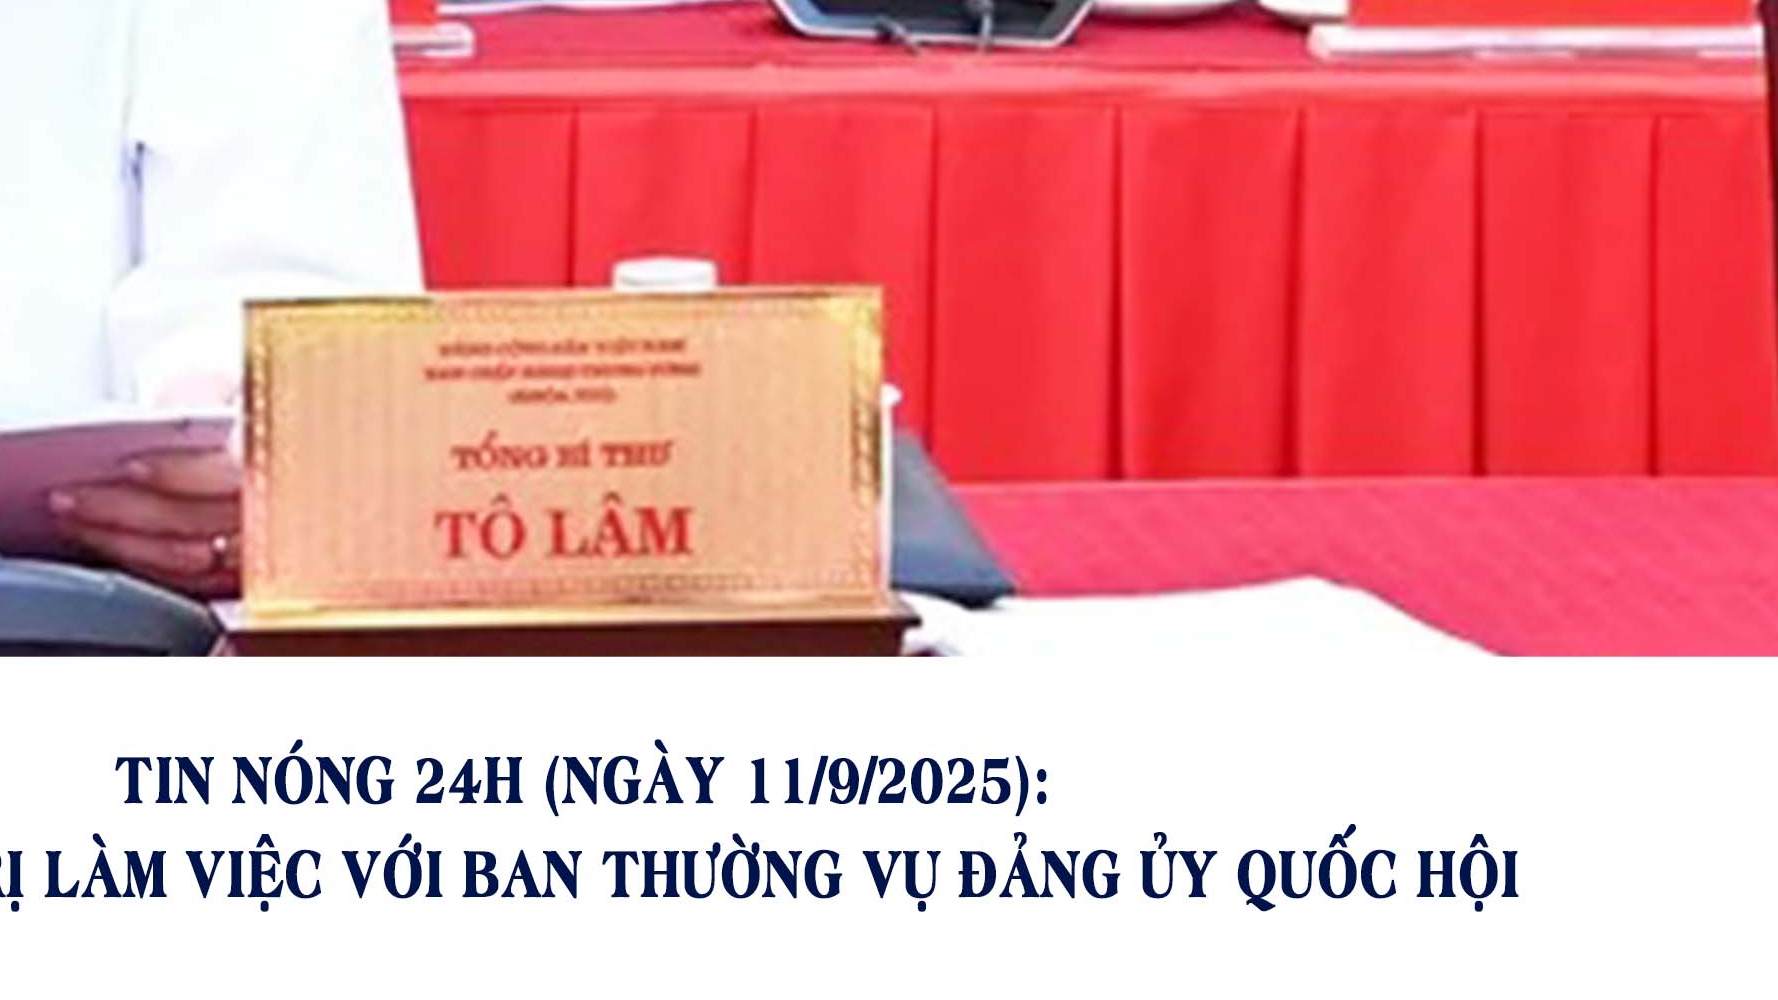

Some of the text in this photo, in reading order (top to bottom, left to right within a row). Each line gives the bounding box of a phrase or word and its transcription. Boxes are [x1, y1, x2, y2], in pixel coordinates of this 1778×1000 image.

[600, 437, 674, 468] THƯ
[434, 491, 693, 560] TÔ LÂM
